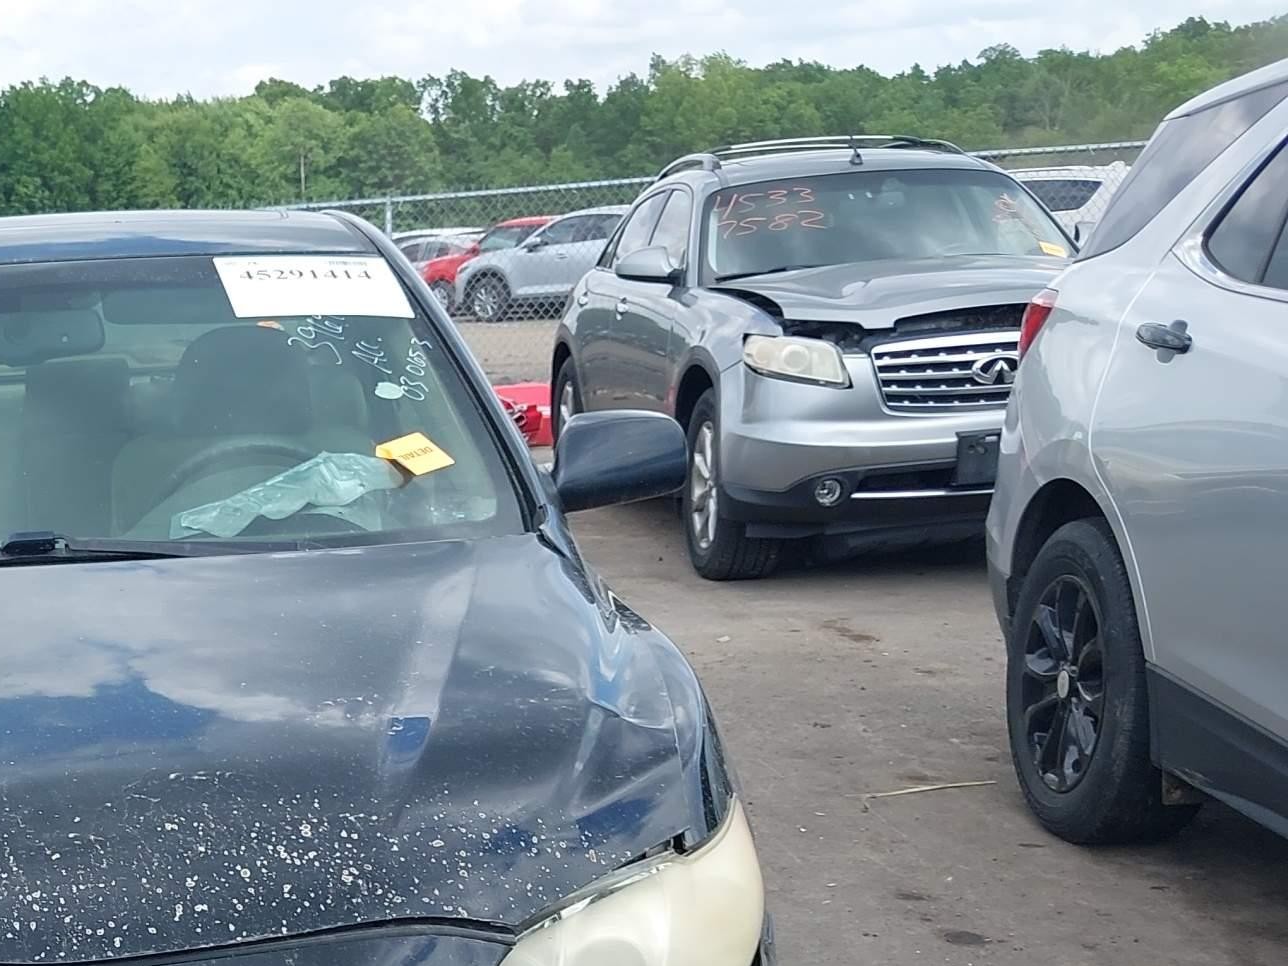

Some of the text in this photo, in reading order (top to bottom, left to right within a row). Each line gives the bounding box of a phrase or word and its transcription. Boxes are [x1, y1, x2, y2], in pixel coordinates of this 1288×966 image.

[713, 187, 815, 220] 4533
[240, 268, 372, 281] 45291414
[398, 445, 434, 461] DETAIL
